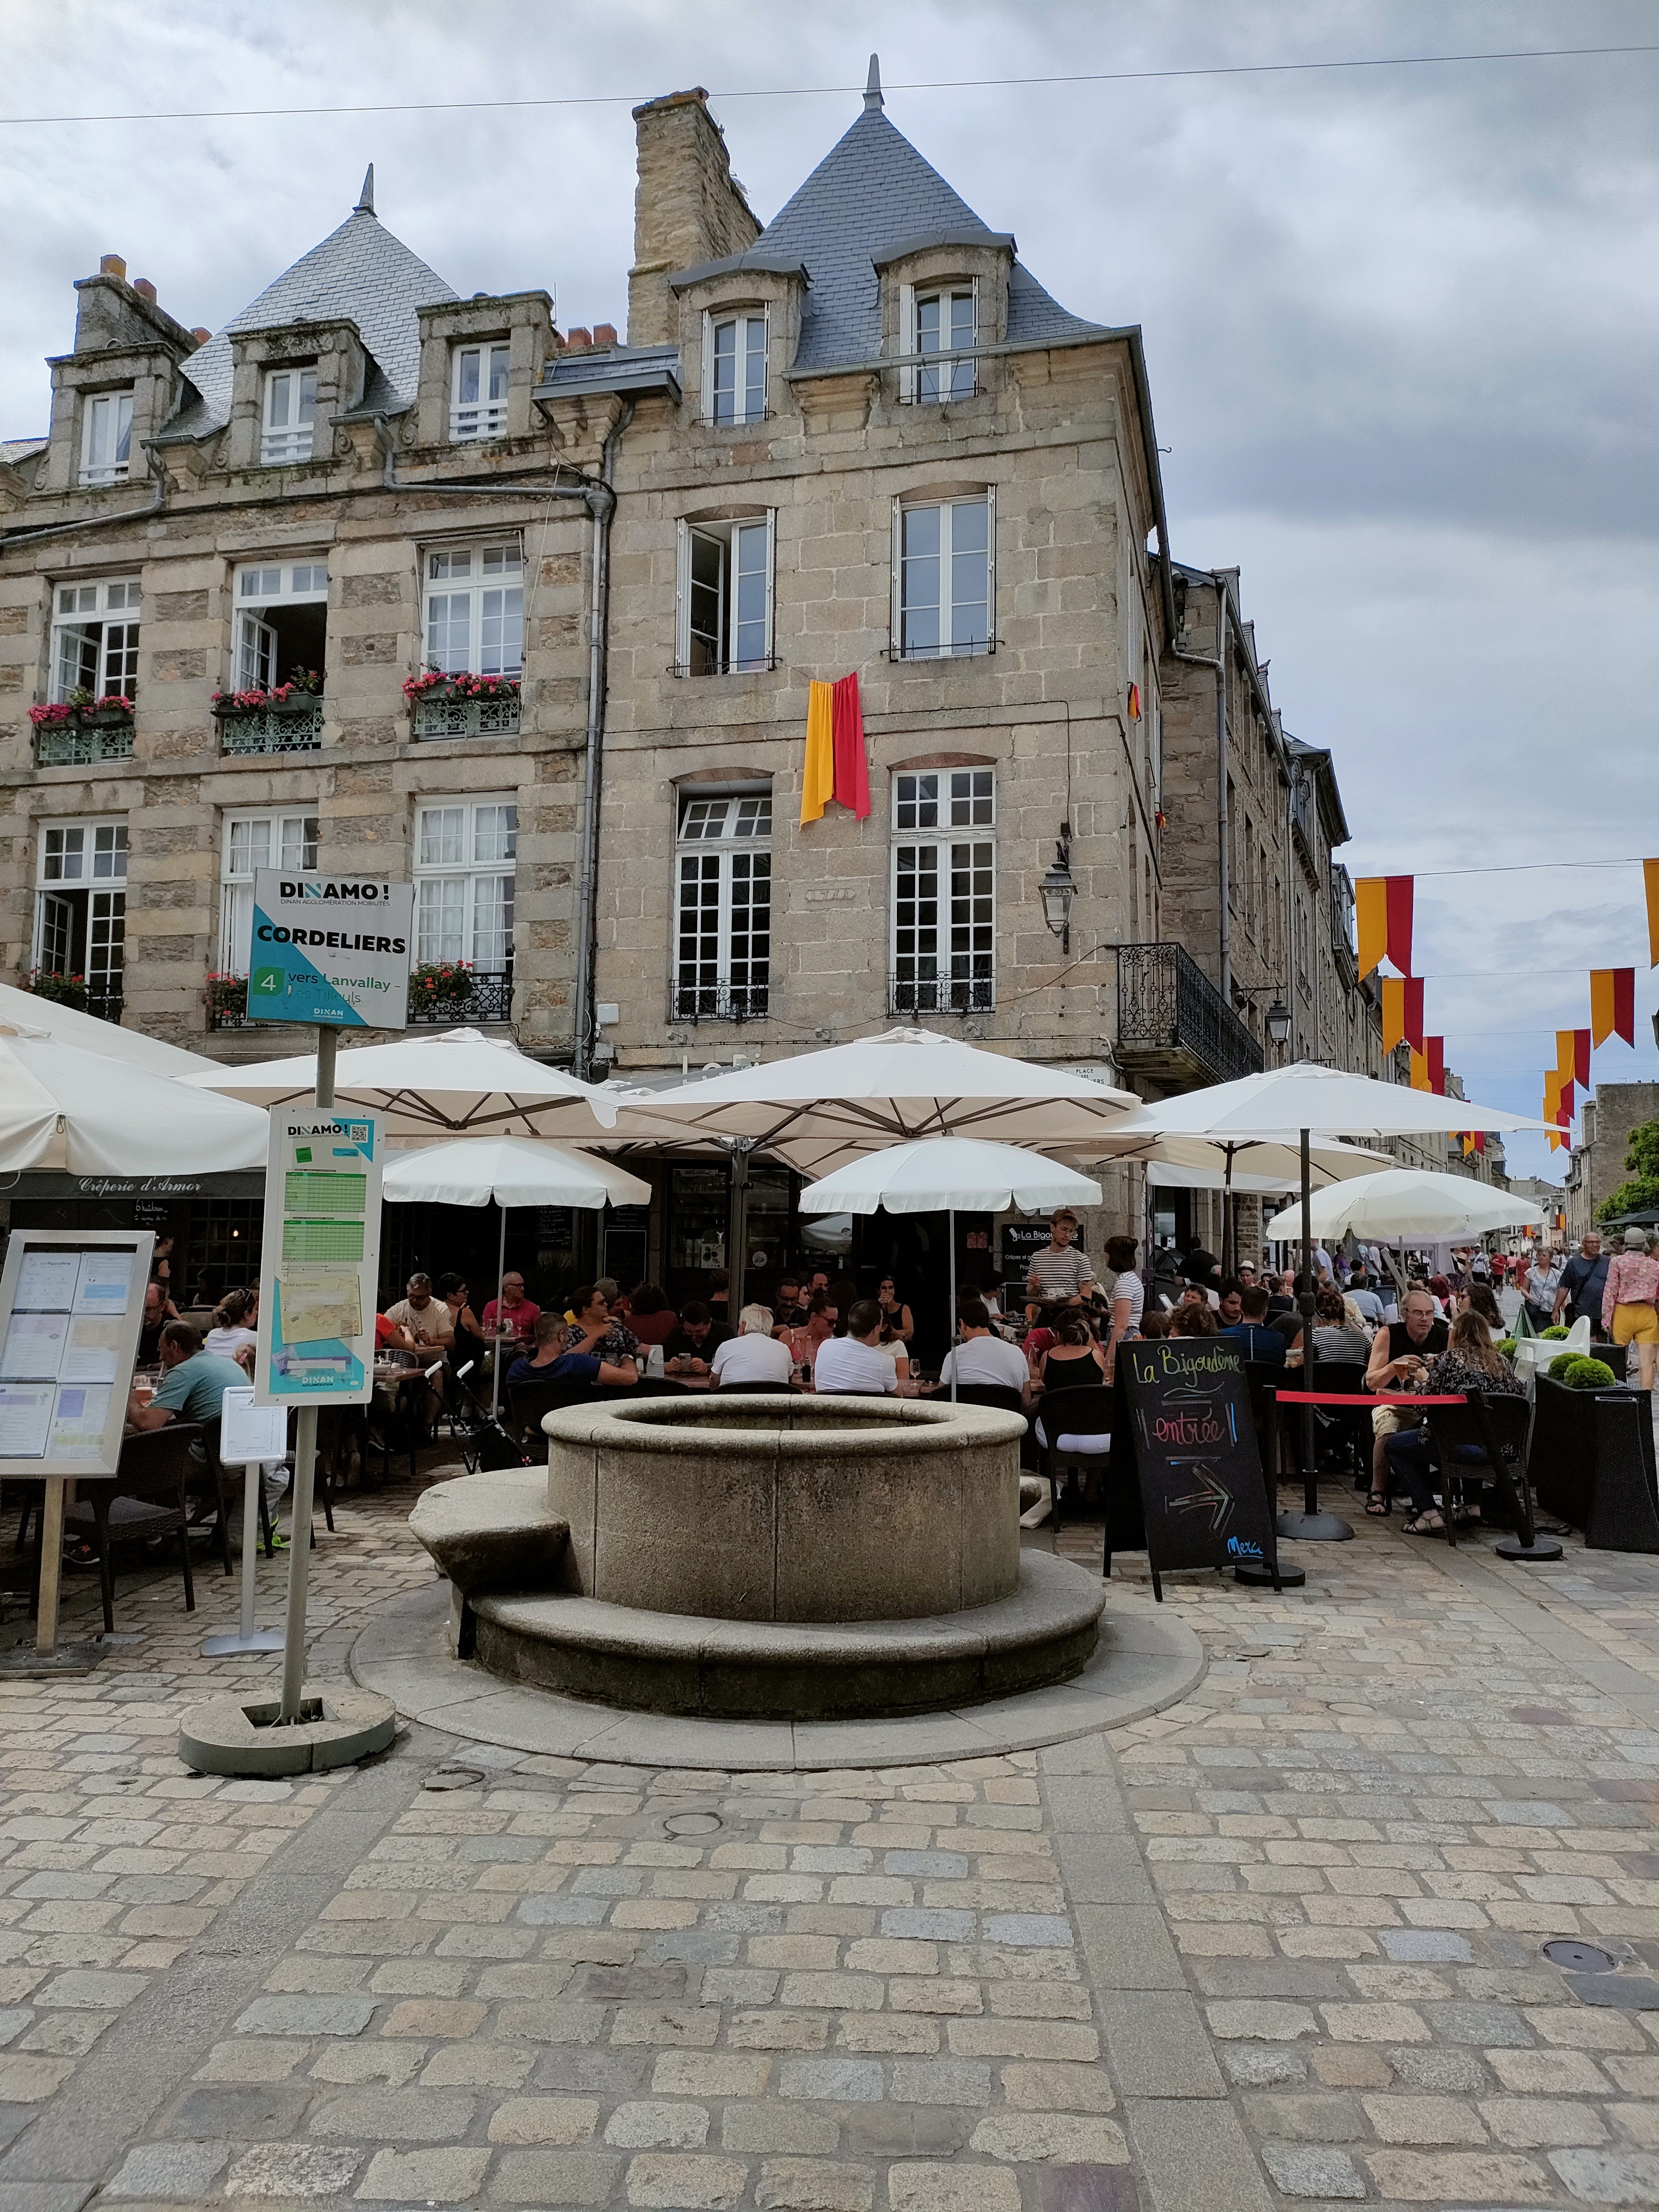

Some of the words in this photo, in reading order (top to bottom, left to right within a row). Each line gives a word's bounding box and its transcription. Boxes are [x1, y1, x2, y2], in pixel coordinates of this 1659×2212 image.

[257, 925, 406, 954] CORDELIERS
[261, 974, 276, 991] 4
[288, 973, 318, 984] vers
[323, 973, 391, 993] Lanvallay
[79, 1176, 136, 1196] Crêperie
[141, 1176, 202, 1191] d'Armor
[1021, 1230, 1031, 1238] La
[1133, 1353, 1160, 1384] La
[1227, 1536, 1263, 1555] Merci
